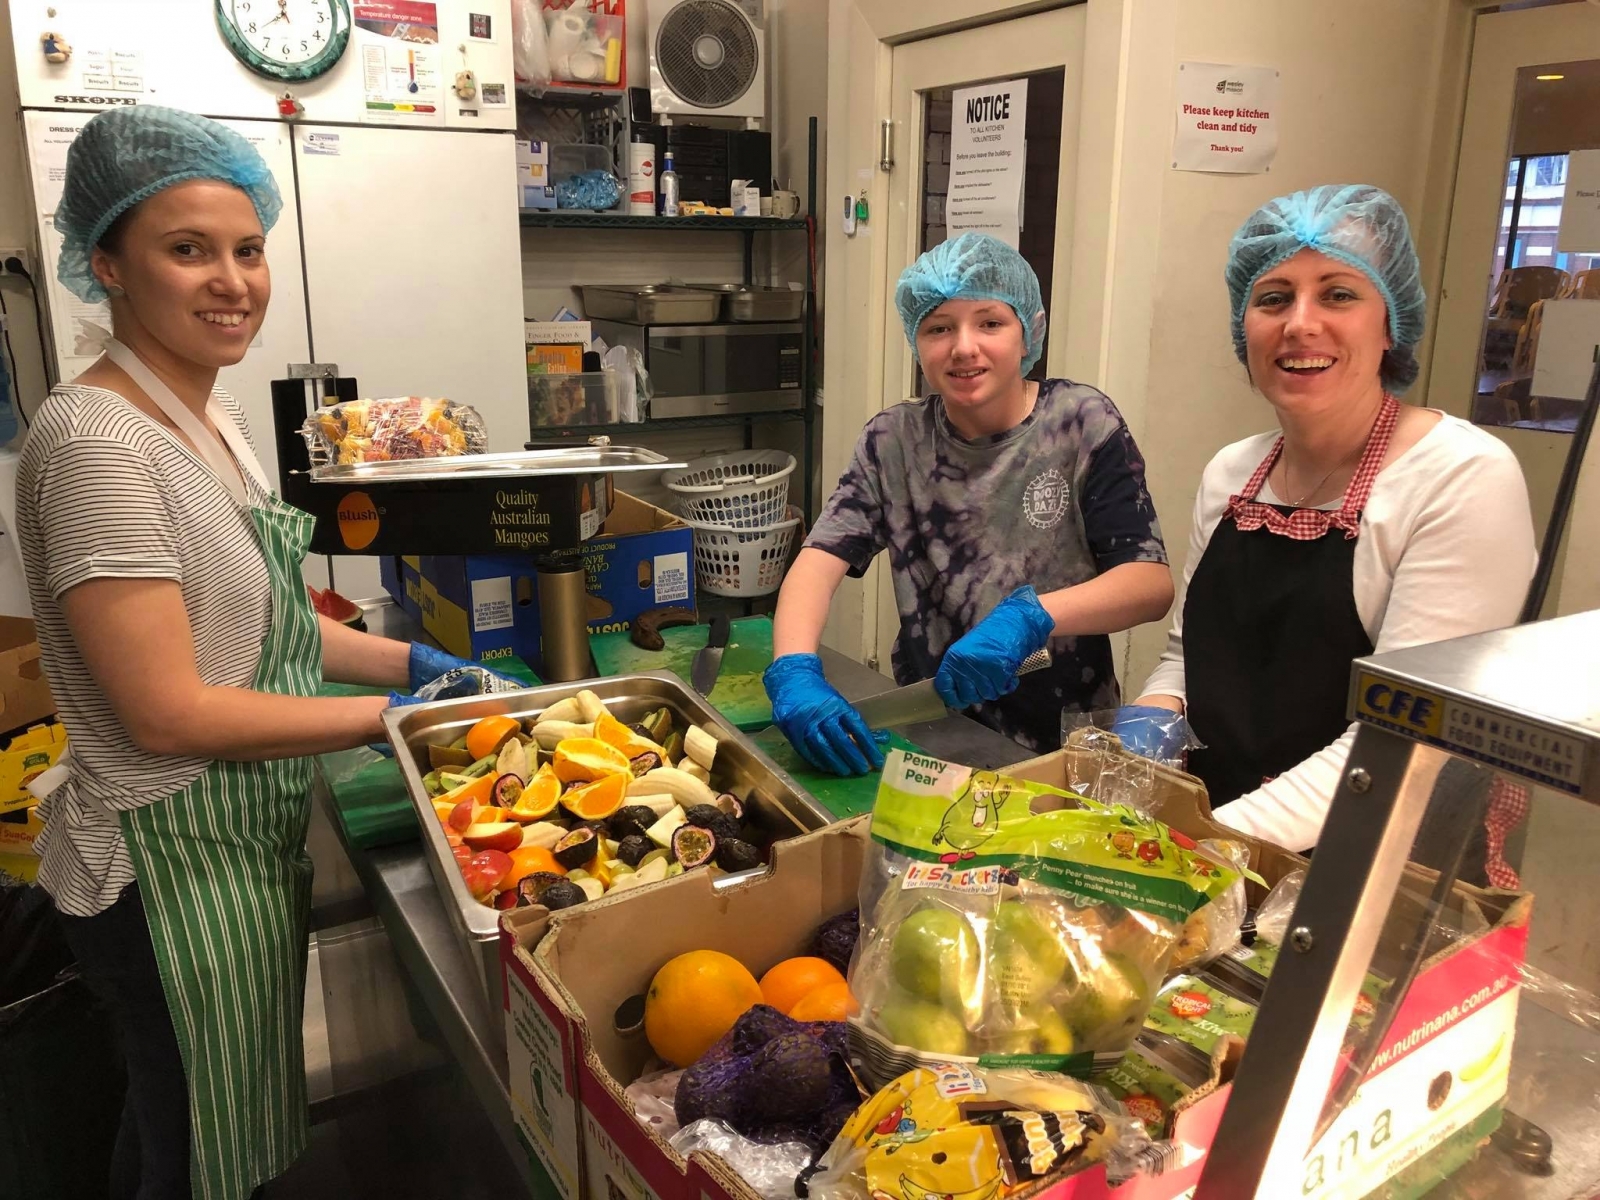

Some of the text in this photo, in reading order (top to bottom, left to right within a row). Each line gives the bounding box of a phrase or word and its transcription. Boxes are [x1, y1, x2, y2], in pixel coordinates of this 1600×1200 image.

[242, 2, 251, 13] 9
[317, 12, 324, 23] 3
[360, 10, 391, 19] Temperature
[392, 13, 410, 21] danger
[249, 22, 257, 33] 8
[312, 30, 321, 40] 4
[263, 36, 271, 48] 7
[300, 40, 308, 51] 5
[282, 44, 290, 55] 6
[54, 95, 137, 106] SKOPE
[966, 93, 1010, 124] NOTICE
[1183, 104, 1270, 119] Please keep kitchen
[985, 124, 1005, 132] KITCHEN
[1197, 121, 1258, 134] clean and tidy
[972, 134, 1002, 143] VOLUNTEERS
[1210, 144, 1230, 152] Thank
[956, 152, 969, 160] Before
[553, 331, 572, 339] FOOD
[495, 489, 539, 509] Quality
[339, 509, 377, 521] Blush
[490, 509, 550, 525] Australian
[495, 528, 549, 548] Mangoes
[581, 545, 589, 554] OF
[590, 542, 616, 553] PRODUCT
[481, 647, 512, 661] EXPORT
[1364, 683, 1436, 728] CFE
[1449, 707, 1574, 759] COMMERCIAL
[1448, 726, 1573, 778] FOOD EQUIPMENT
[903, 752, 947, 774] Penny
[905, 769, 938, 787] Pear
[1042, 863, 1064, 876] Penny
[1065, 869, 1082, 879] Pear
[1083, 872, 1114, 886] munches
[1124, 880, 1137, 890] fruit
[919, 880, 943, 888] happy
[951, 885, 979, 893] healthy
[1075, 879, 1082, 887] to
[1083, 881, 1104, 892] make
[1105, 886, 1119, 896] sure
[1146, 896, 1167, 907] winner
[1171, 994, 1212, 1010] TROPICAL
